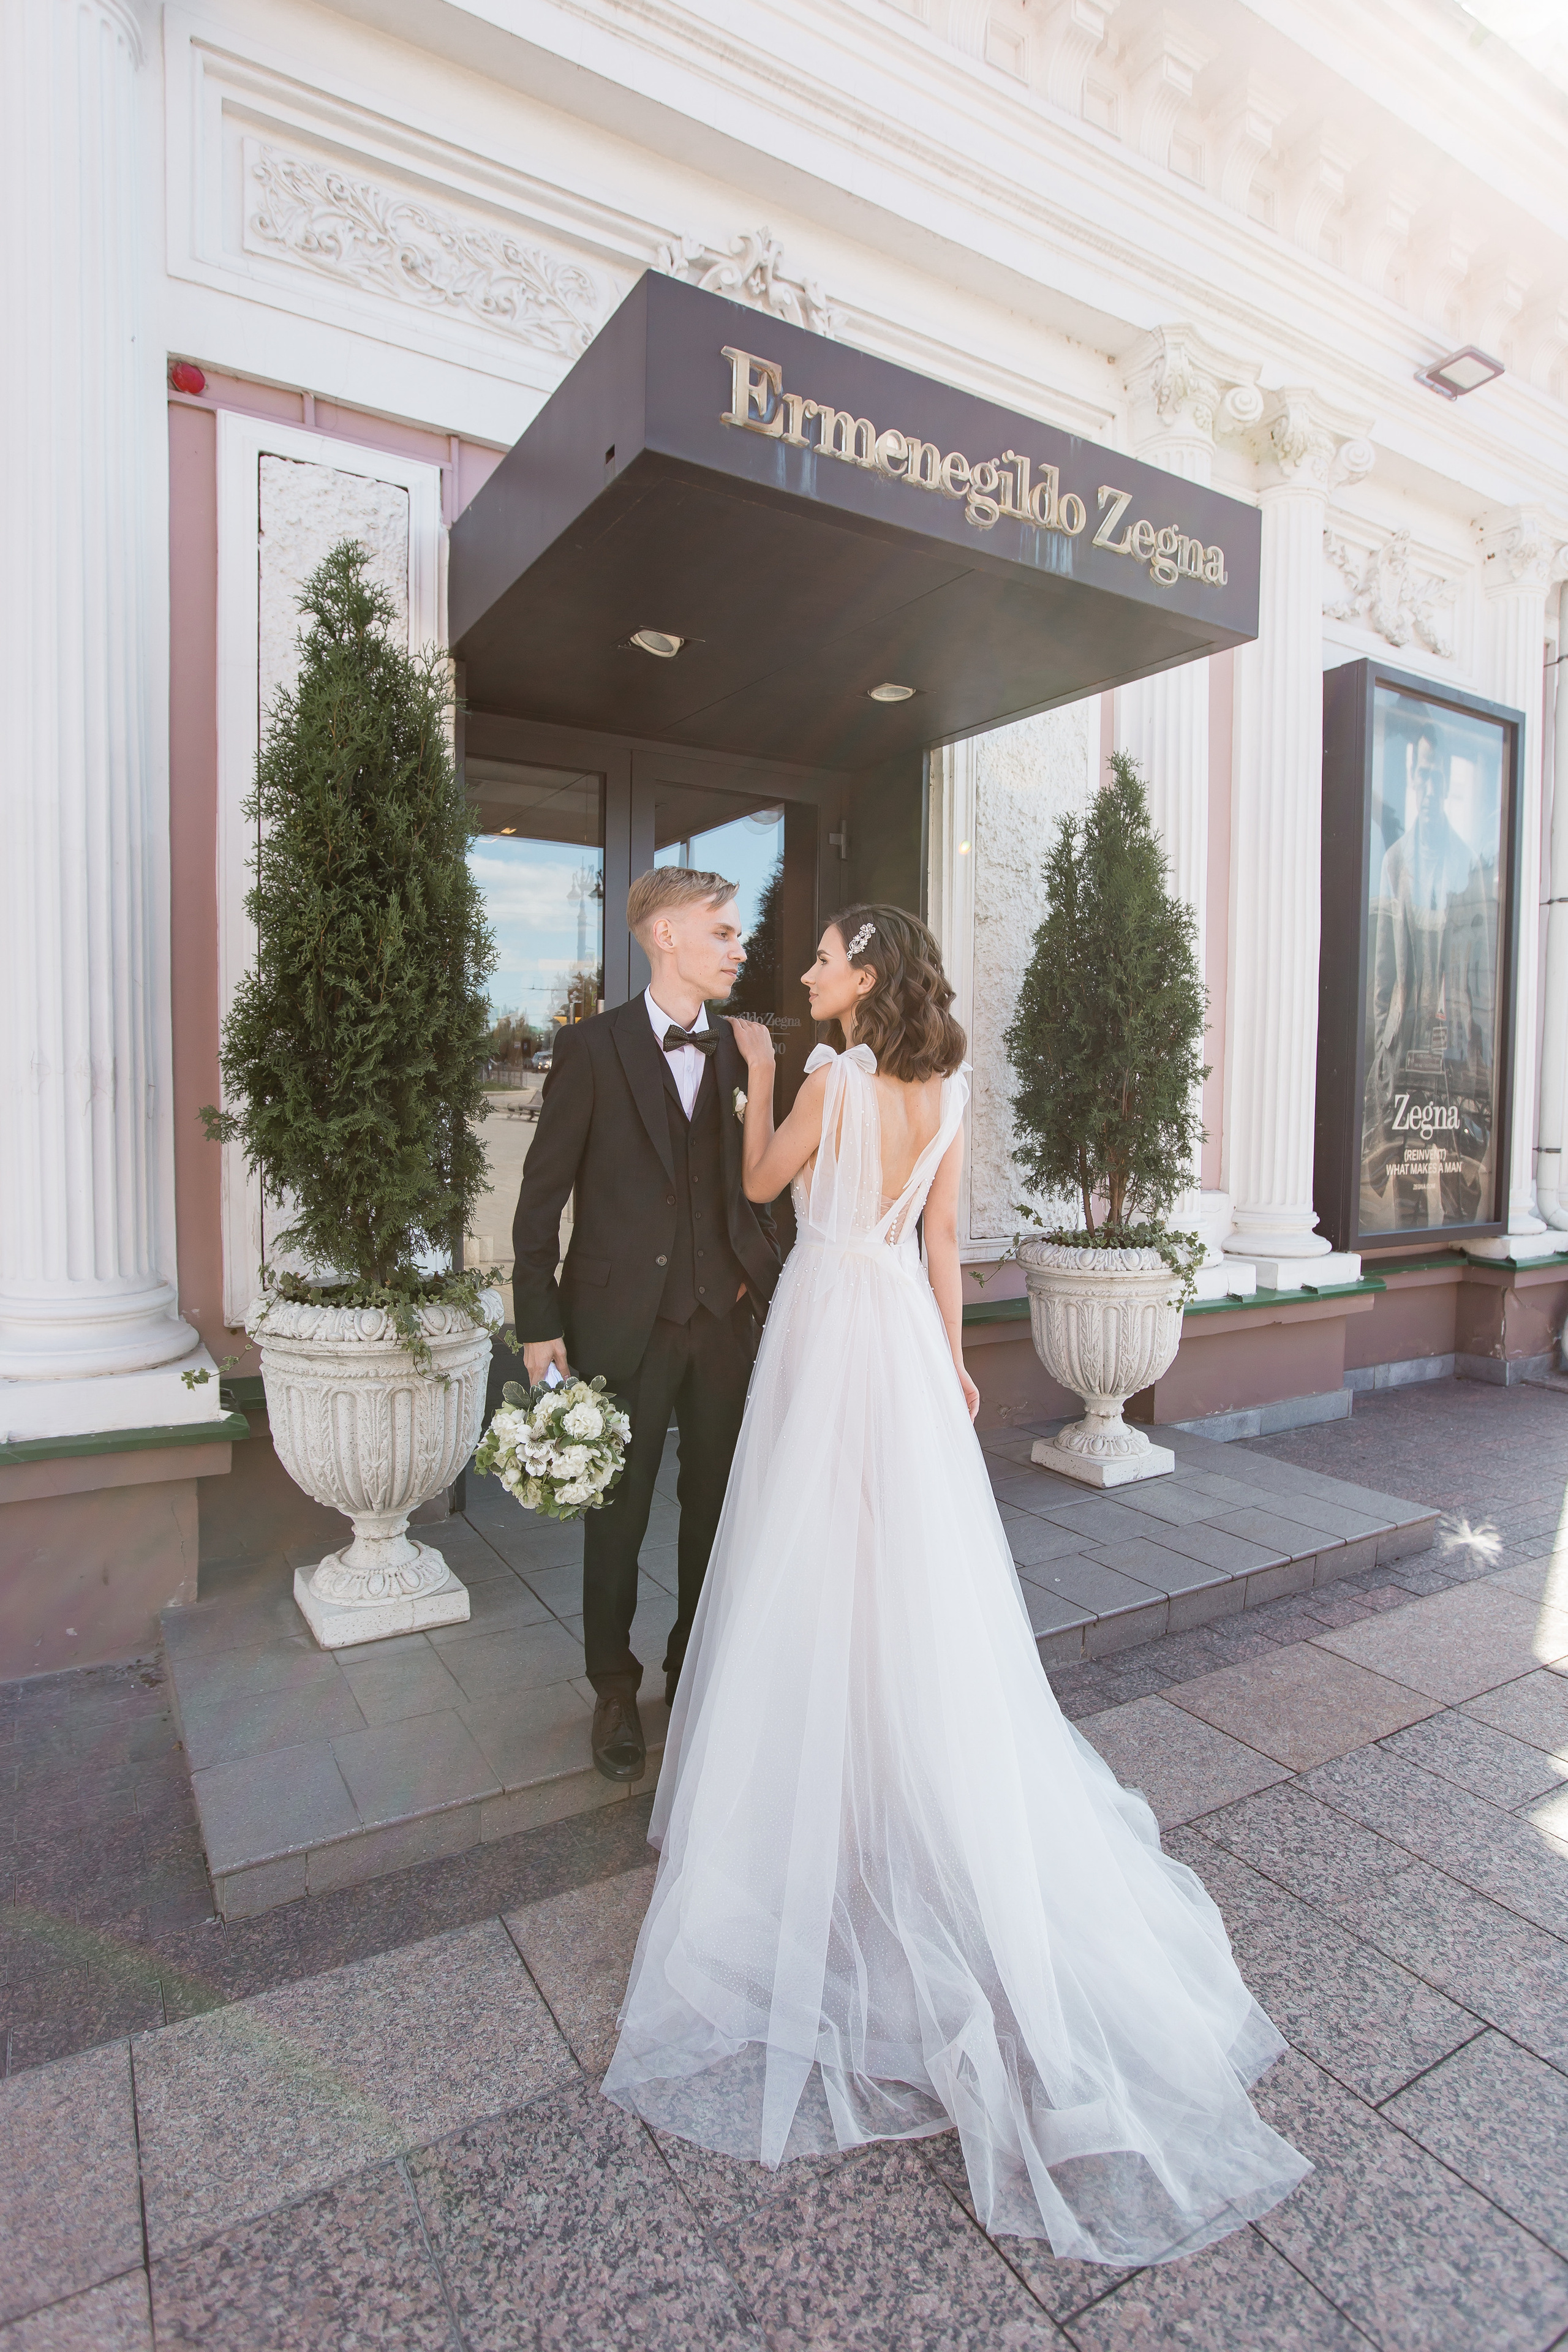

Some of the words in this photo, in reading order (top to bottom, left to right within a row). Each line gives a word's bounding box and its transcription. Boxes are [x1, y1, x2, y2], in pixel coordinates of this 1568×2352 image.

[720, 345, 1087, 537] Ermenegildo
[1092, 485, 1228, 587] Zegna
[766, 1012, 802, 1030] Zegna
[1392, 1094, 1460, 1140] Zegna
[1404, 1148, 1446, 1163] (REINVENT)
[1385, 1164, 1409, 1175] WHAT
[1410, 1163, 1438, 1174] MAKES
[1438, 1162, 1444, 1173] A
[1444, 1161, 1462, 1173] MAN
